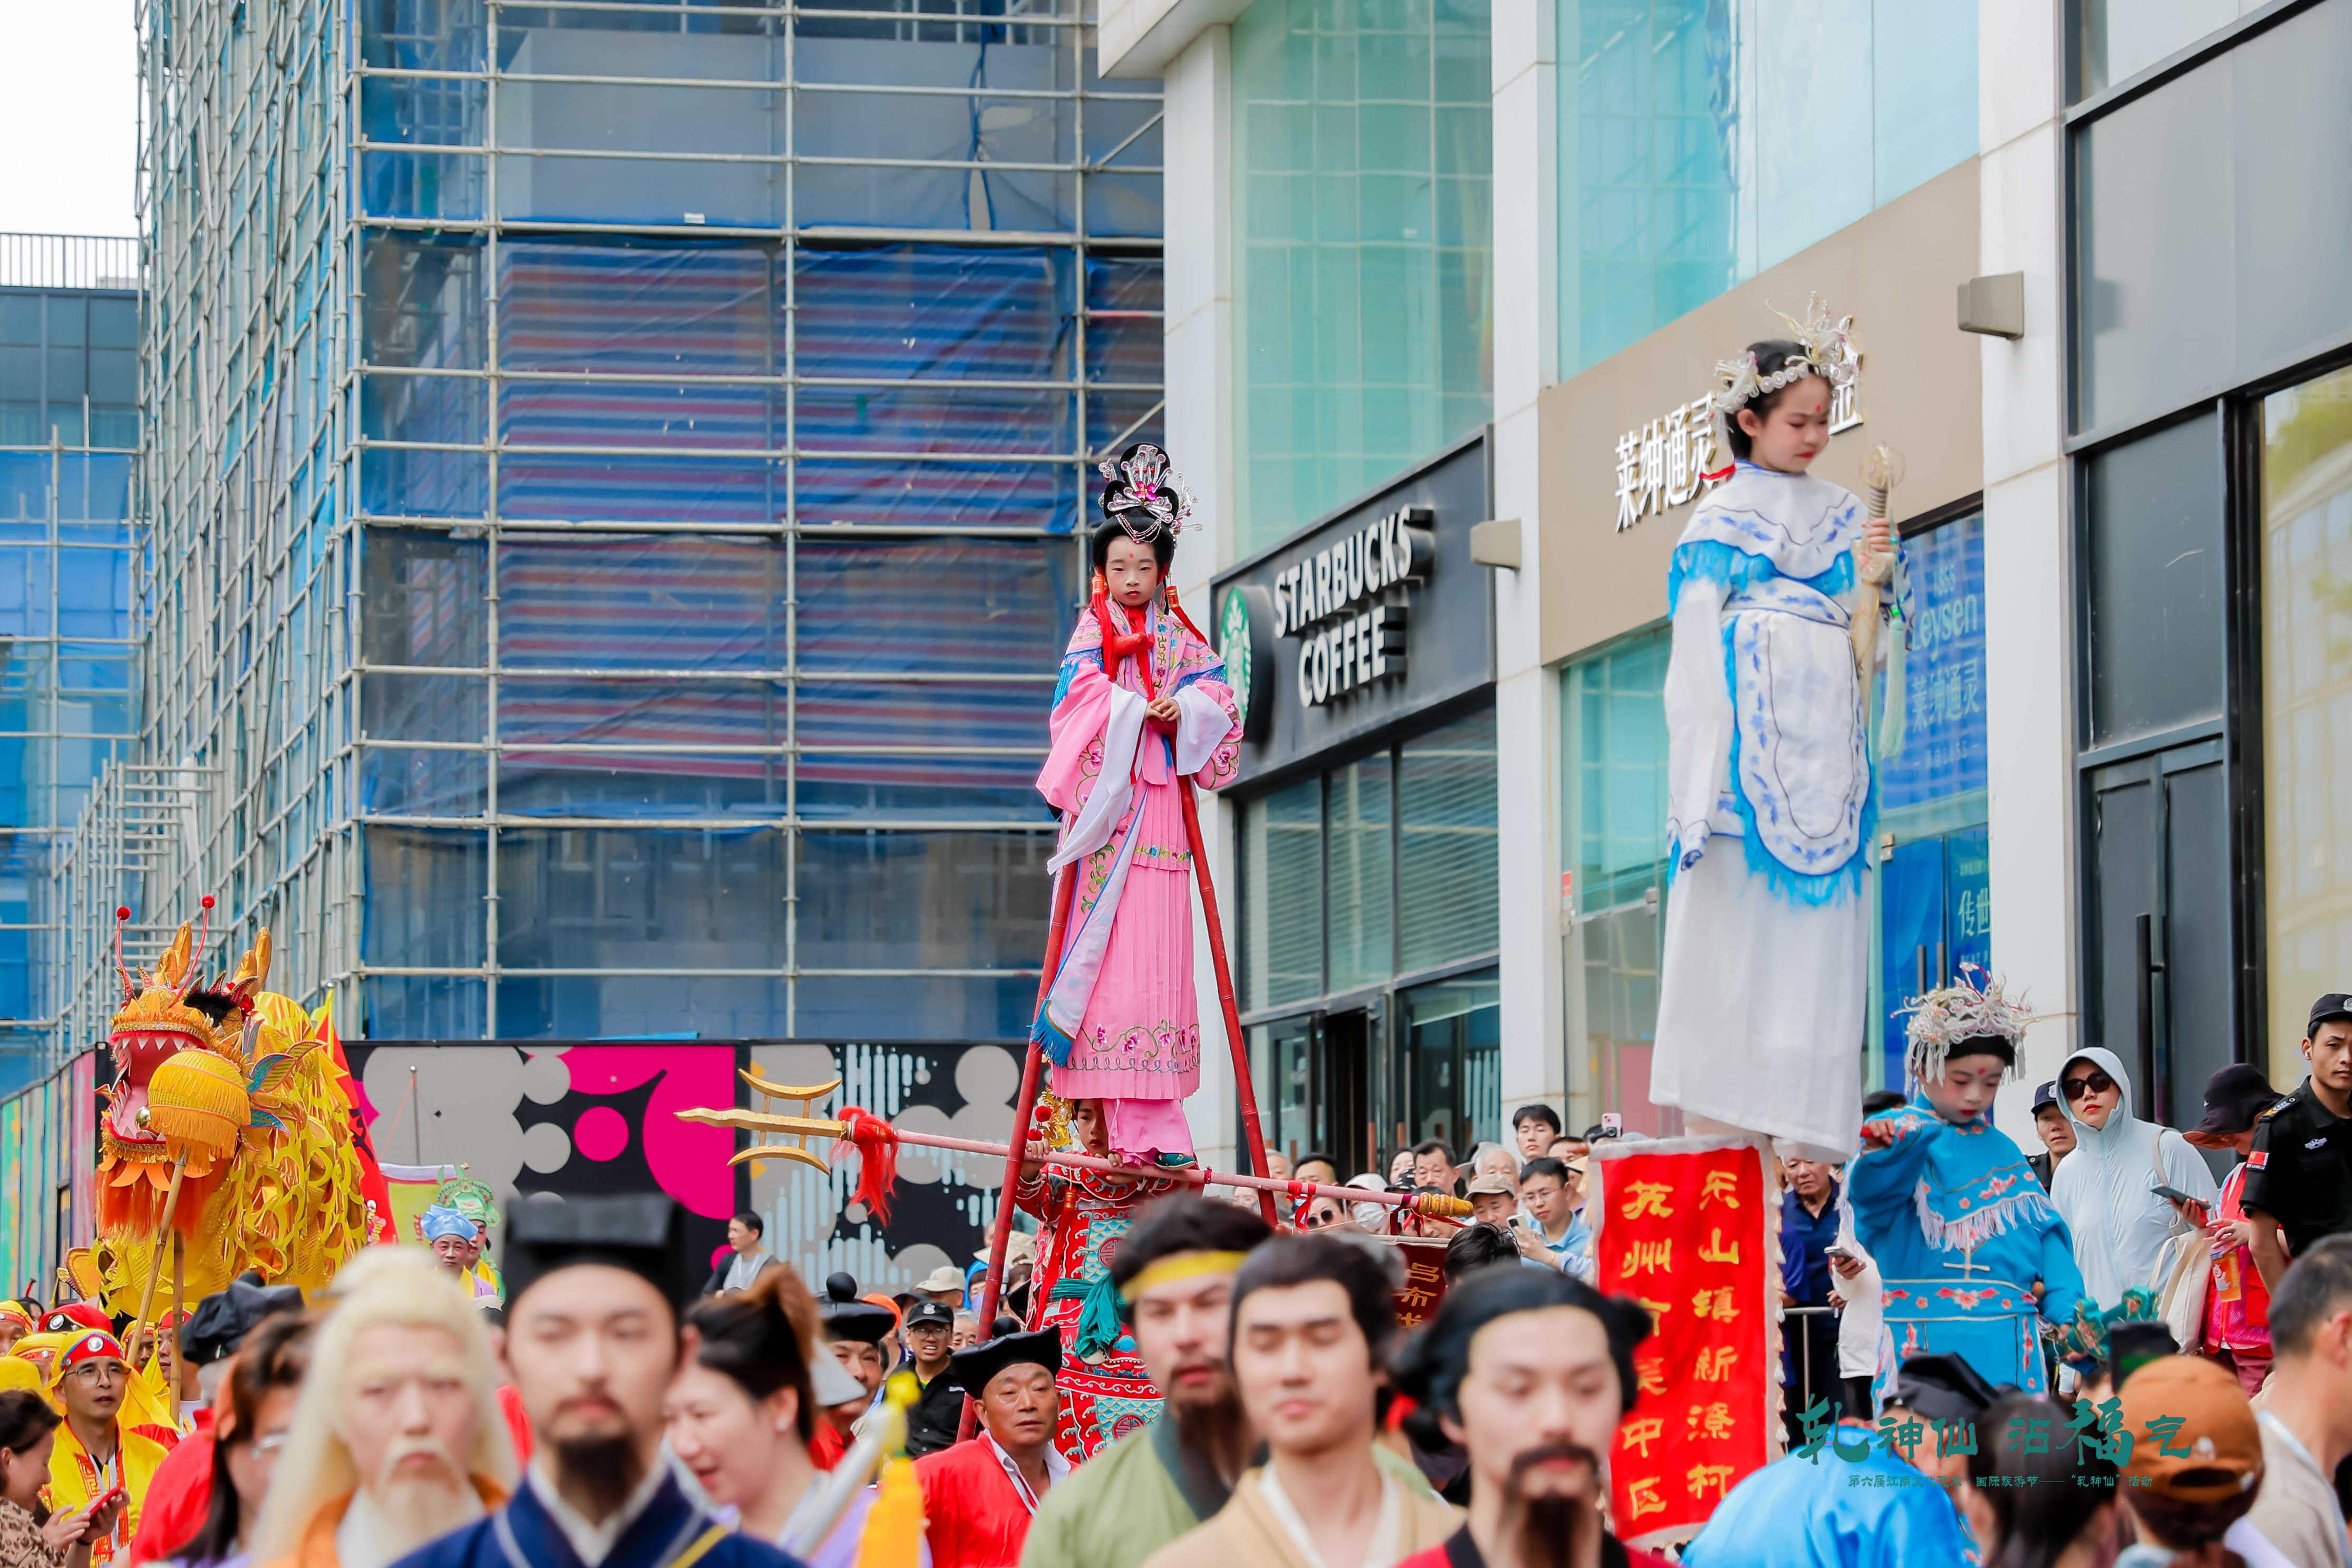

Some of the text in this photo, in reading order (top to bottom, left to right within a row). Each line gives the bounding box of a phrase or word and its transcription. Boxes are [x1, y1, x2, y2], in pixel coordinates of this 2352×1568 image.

[1615, 391, 1716, 533] 莱绅通灵
[1274, 505, 1412, 638] STARBUCKS
[1298, 606, 1386, 707] COFFEE
[1912, 658, 1980, 733] 莱绅通灵
